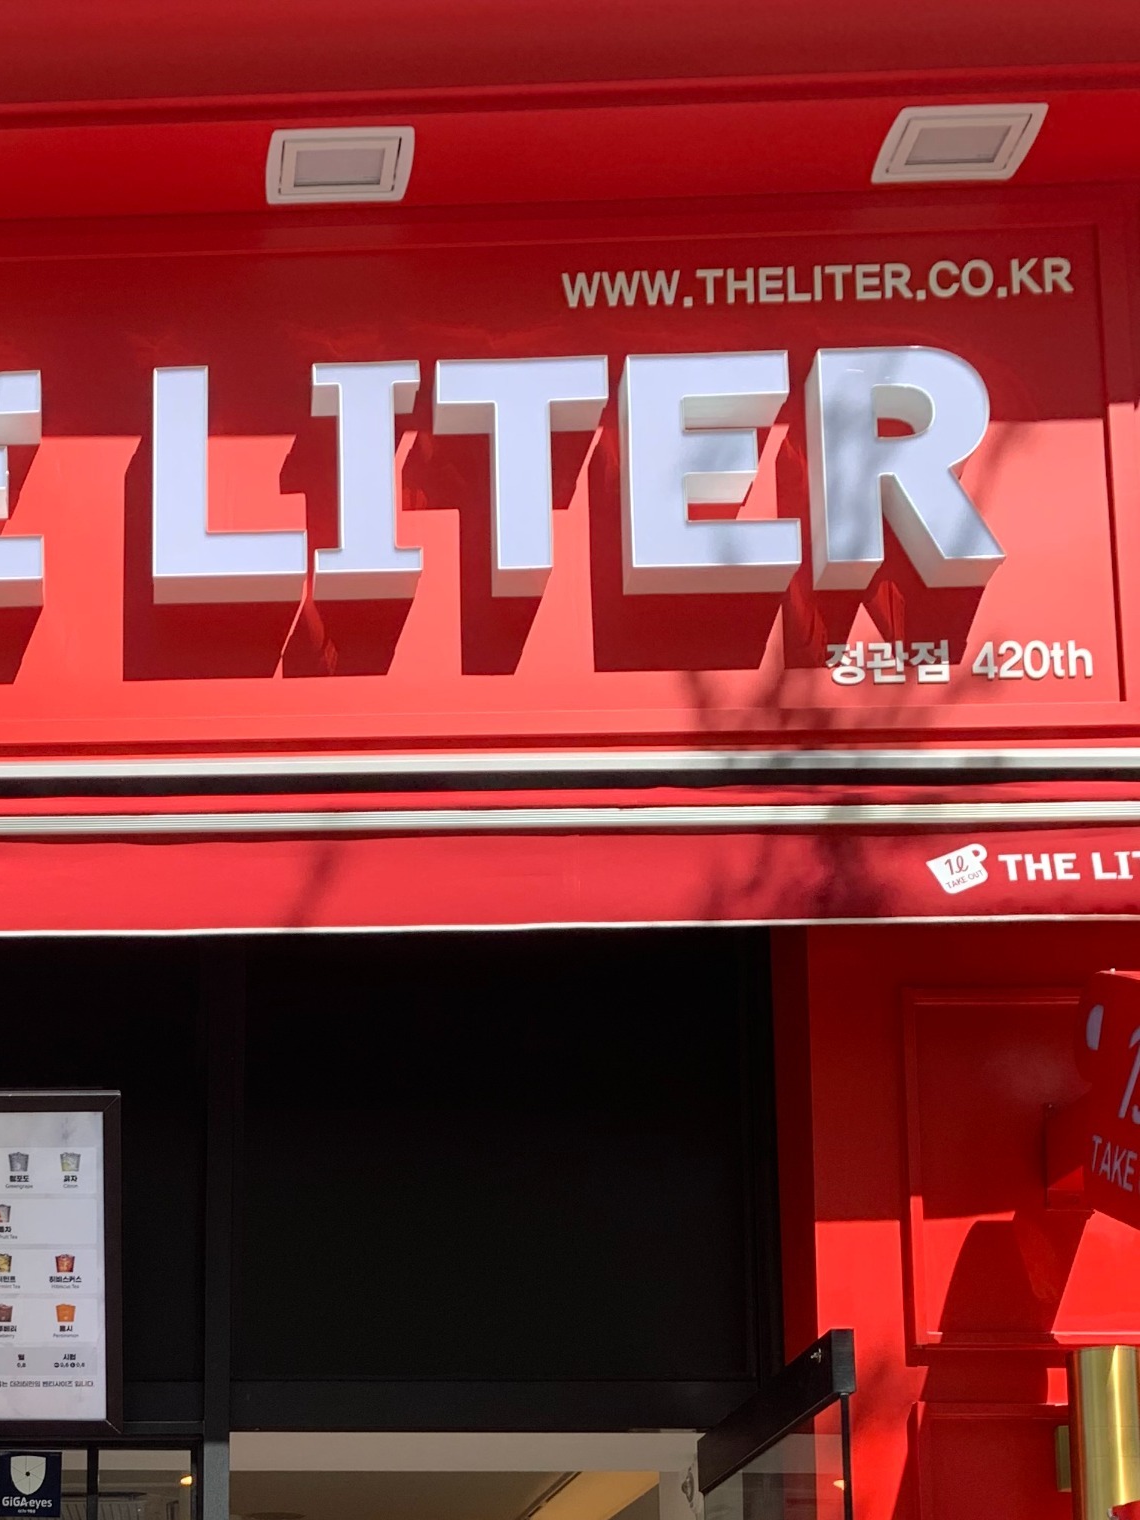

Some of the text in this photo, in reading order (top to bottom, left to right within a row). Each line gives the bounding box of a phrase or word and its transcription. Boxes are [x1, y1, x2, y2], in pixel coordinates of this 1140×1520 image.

[562, 257, 1074, 309] WWW.THELITER.CO.KR
[152, 345, 1006, 602] LITER
[826, 638, 1095, 686] 정관점 420th
[945, 868, 984, 890] TAKE OUT
[998, 853, 1081, 881] THE
[1091, 1134, 1138, 1192] TAKE
